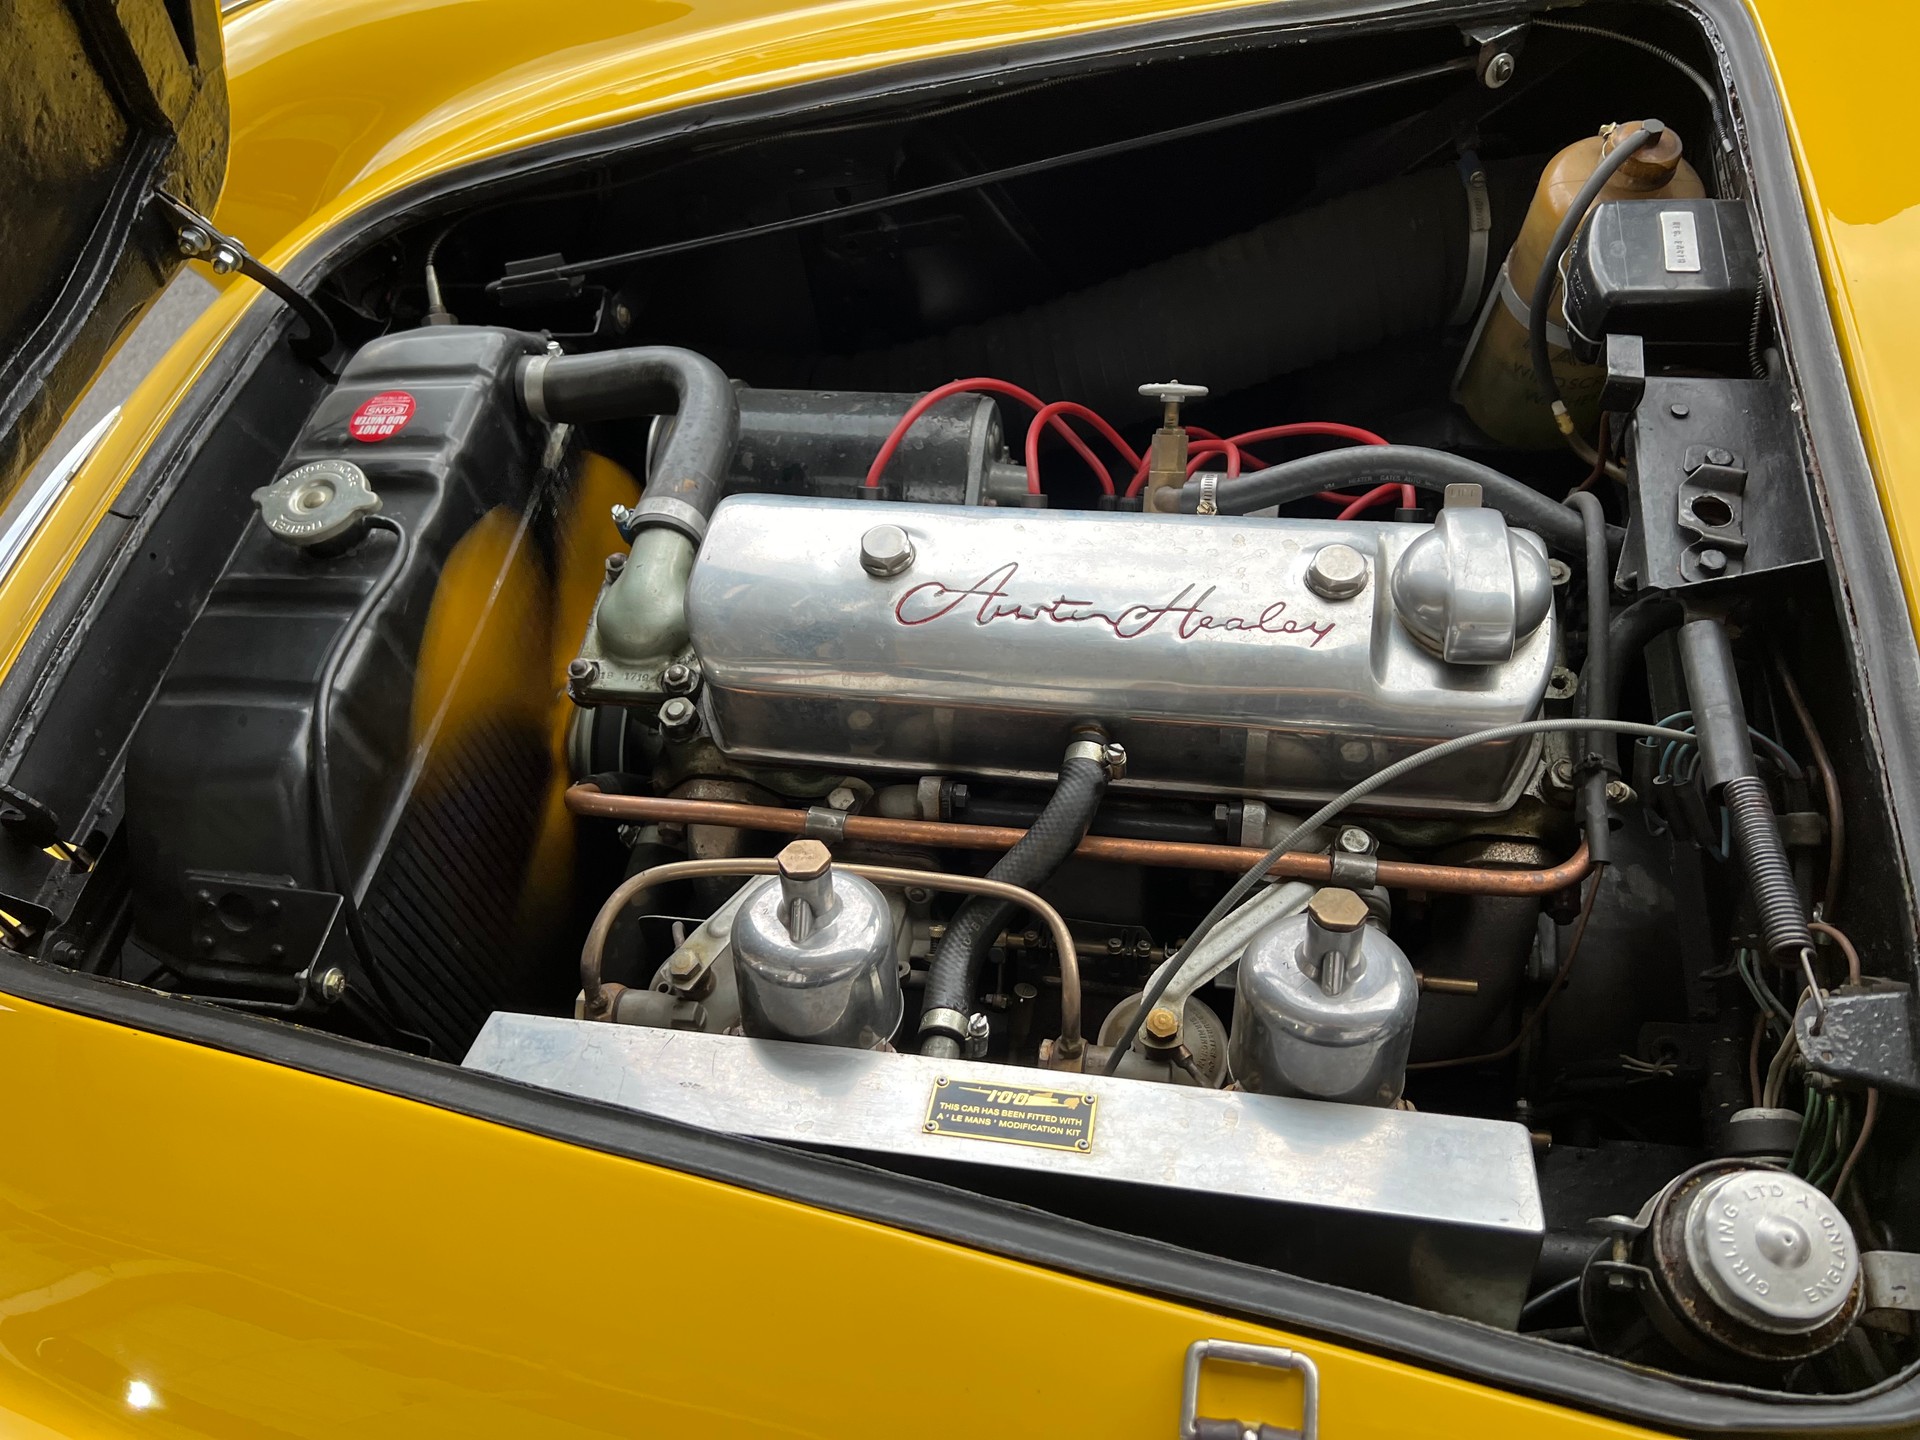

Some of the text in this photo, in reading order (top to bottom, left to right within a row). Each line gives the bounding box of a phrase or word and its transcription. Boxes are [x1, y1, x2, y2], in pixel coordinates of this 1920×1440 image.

[354, 415, 408, 425] ADD WATER
[368, 406, 405, 414] EVANS
[356, 425, 395, 435] DO NOT
[895, 562, 1337, 649] Austin Healey
[936, 1112, 944, 1120] A
[964, 1116, 992, 1126] MANS
[998, 1120, 1064, 1136] MODIFICATION
[1066, 1128, 1082, 1137] KIT
[940, 1102, 1083, 1127] THIS CAR HAS BEEN FITTED WITH
[1743, 1183, 1784, 1201] LTD
[1717, 1203, 1770, 1296] GIRLING
[1803, 1214, 1847, 1304] ENGLAND
